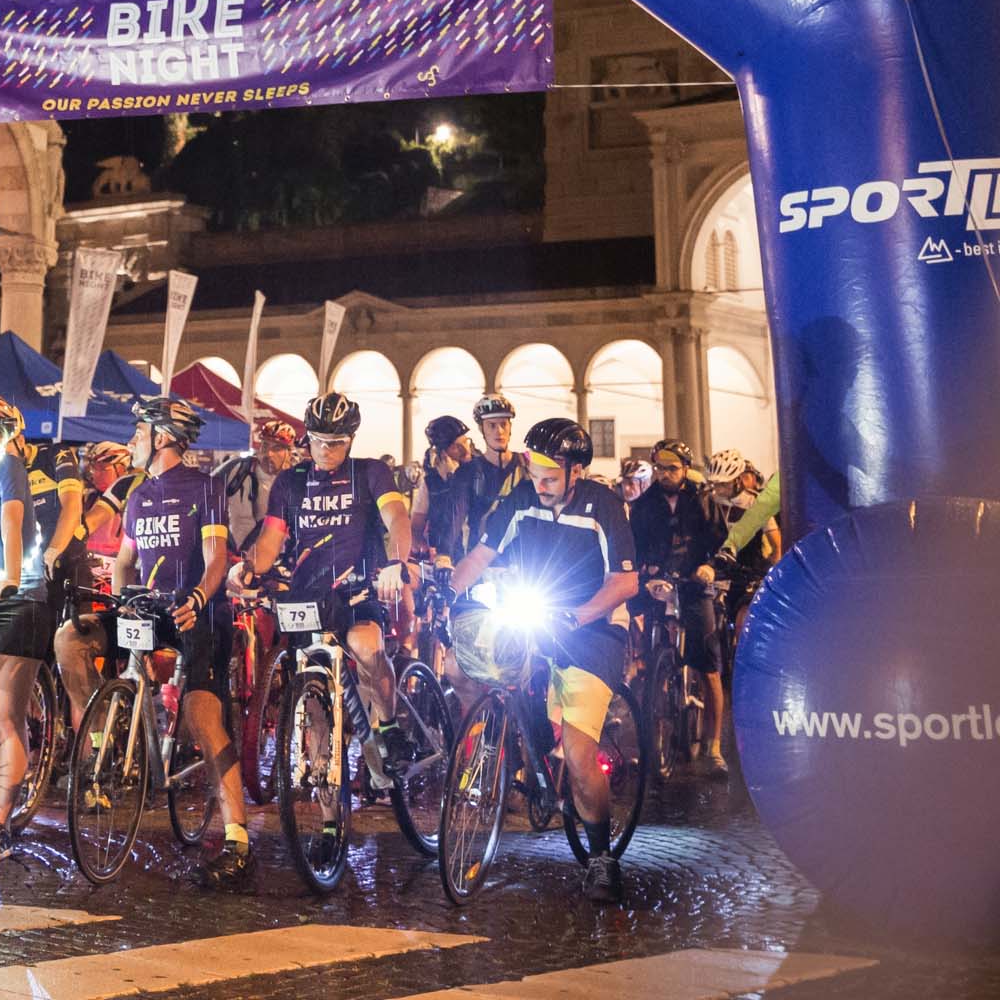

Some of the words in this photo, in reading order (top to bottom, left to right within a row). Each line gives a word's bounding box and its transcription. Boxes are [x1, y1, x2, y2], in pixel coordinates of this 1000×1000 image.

[109, 43, 245, 86] NIGHT
[42, 98, 81, 112] OUR
[87, 95, 171, 110] PASSION
[177, 90, 236, 107] NEVER
[243, 82, 310, 101] SLEEPS
[779, 158, 1000, 233] SPORTL
[80, 268, 115, 282] BIKE
[135, 514, 180, 536] BIKE
[135, 534, 180, 550] NIGHT
[290, 610, 306, 622] 79
[126, 628, 141, 640] 52
[772, 703, 1000, 747] www.sportl
